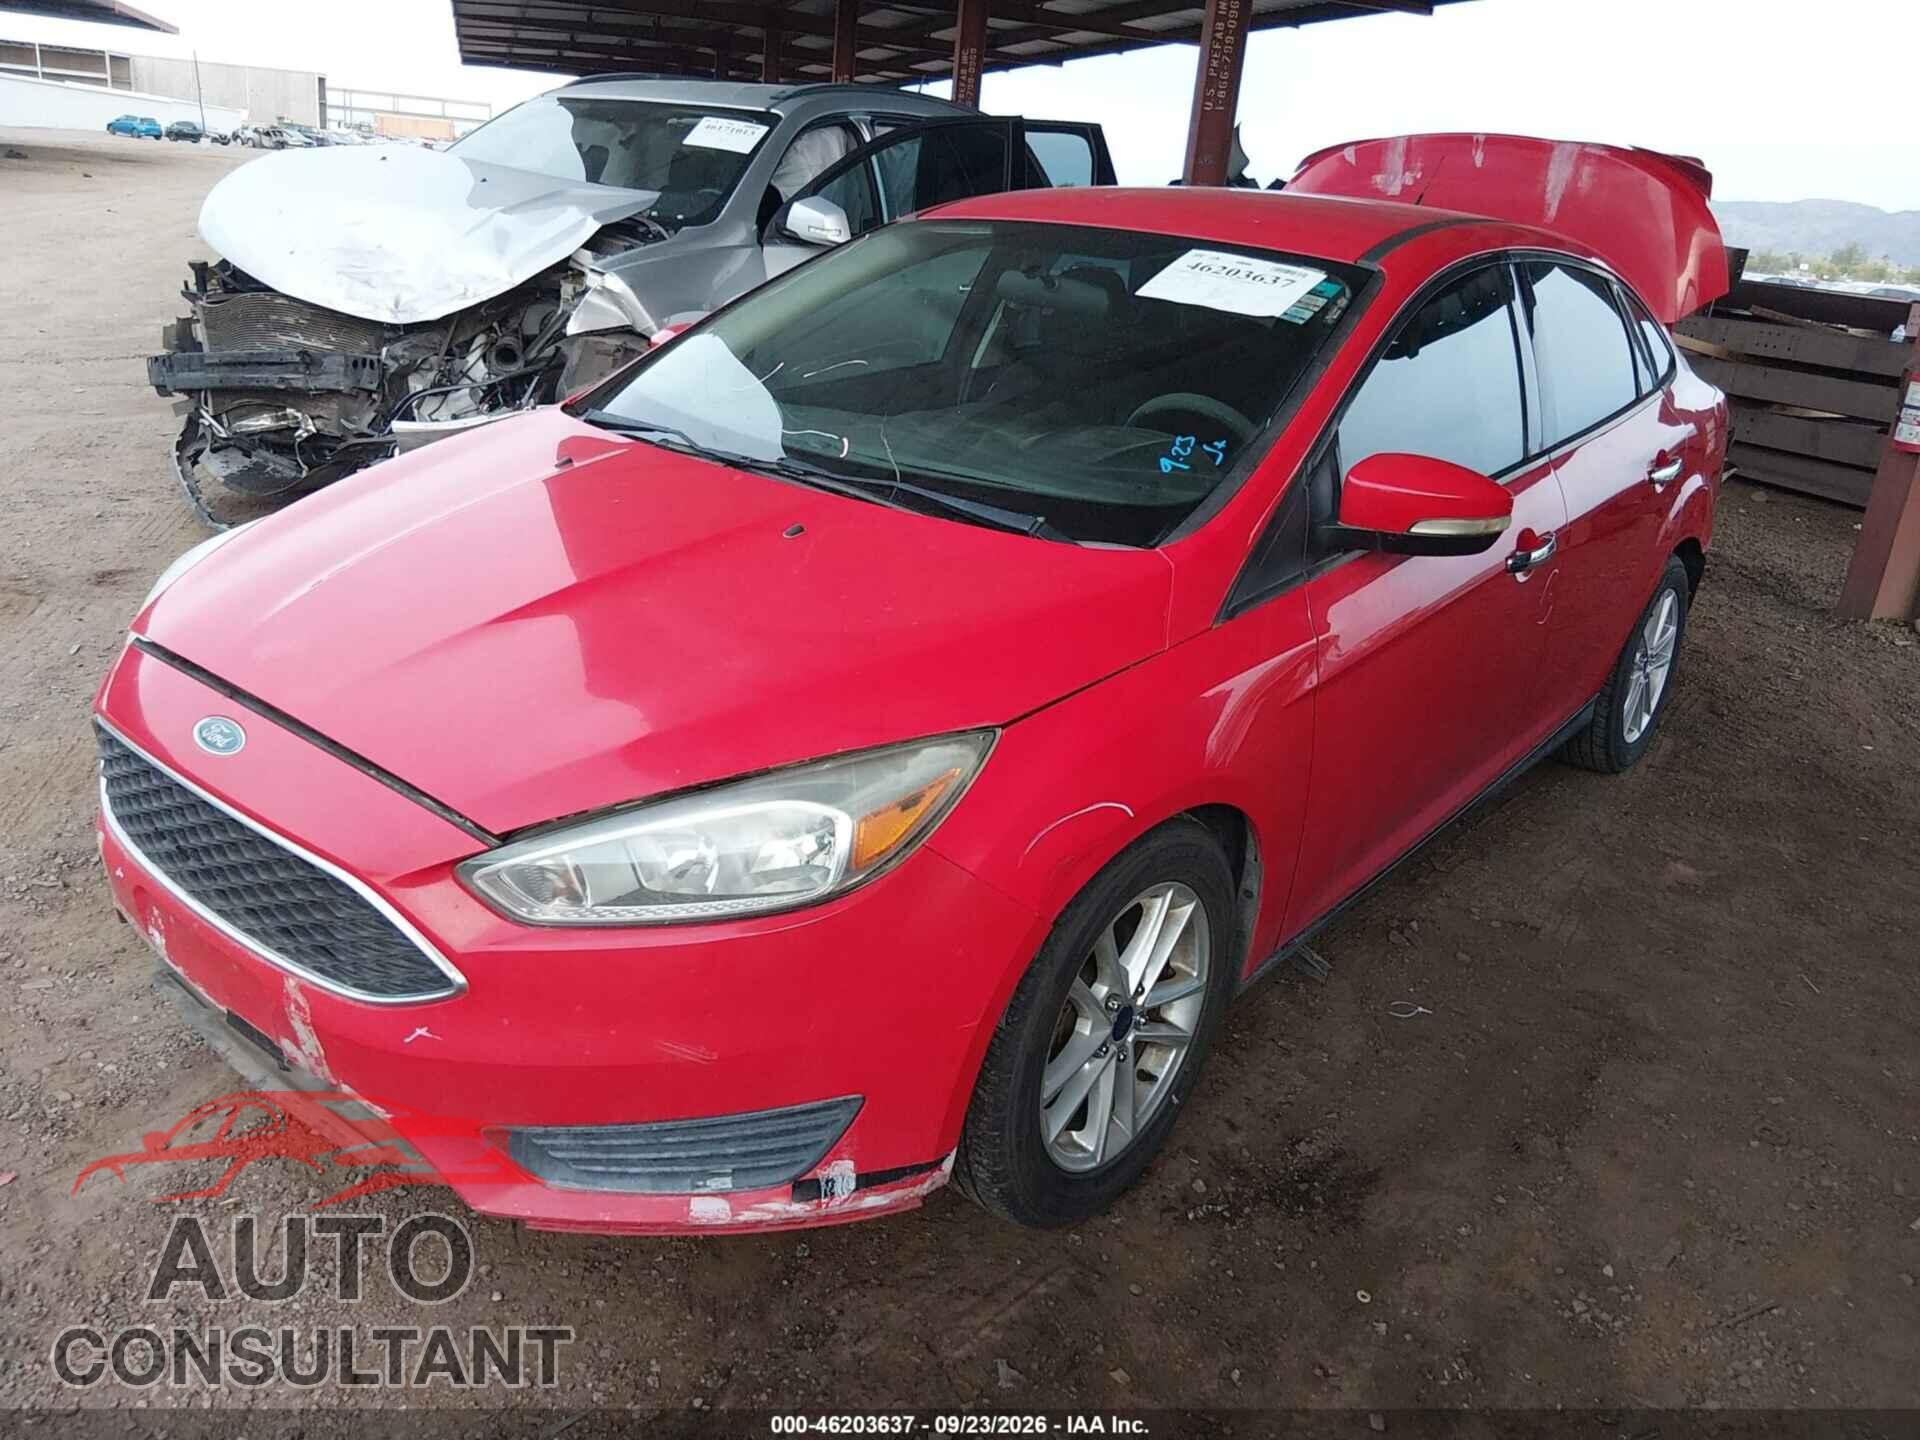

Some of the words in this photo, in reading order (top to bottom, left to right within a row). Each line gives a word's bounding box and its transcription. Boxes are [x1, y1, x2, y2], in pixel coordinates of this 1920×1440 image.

[1208, 21, 1225, 77] PREFAB
[1217, 0, 1228, 15] IN
[1186, 261, 1296, 289] 46203637
